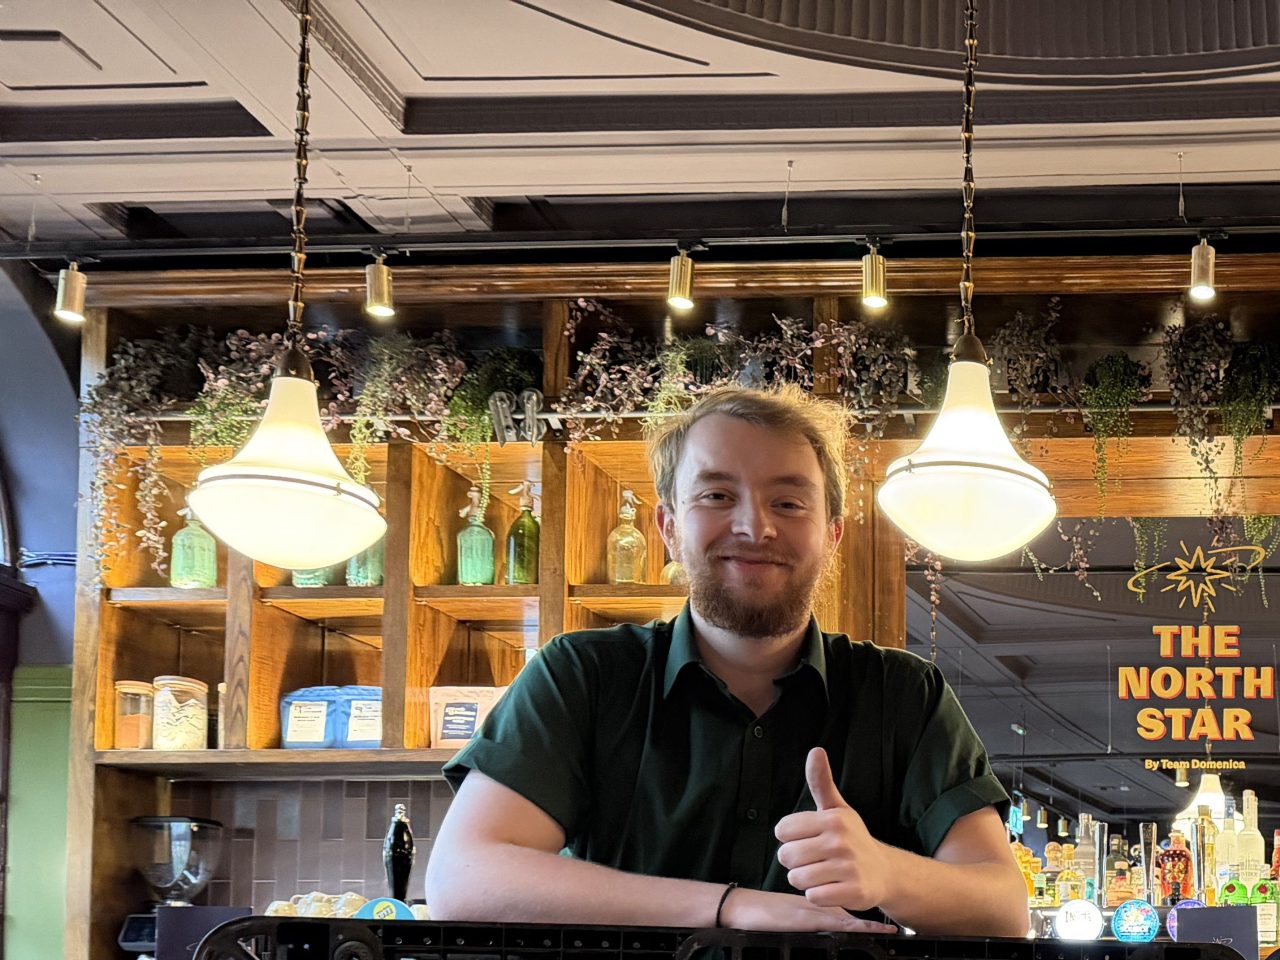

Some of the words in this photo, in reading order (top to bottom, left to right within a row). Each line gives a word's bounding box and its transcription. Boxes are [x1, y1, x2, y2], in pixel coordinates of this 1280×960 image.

[1152, 625, 1241, 658] THE
[1118, 666, 1275, 700] NORTH
[1136, 707, 1255, 741] STAR
[1144, 759, 1159, 771] By
[1161, 759, 1190, 769] Team
[1191, 759, 1246, 769] Domenica
